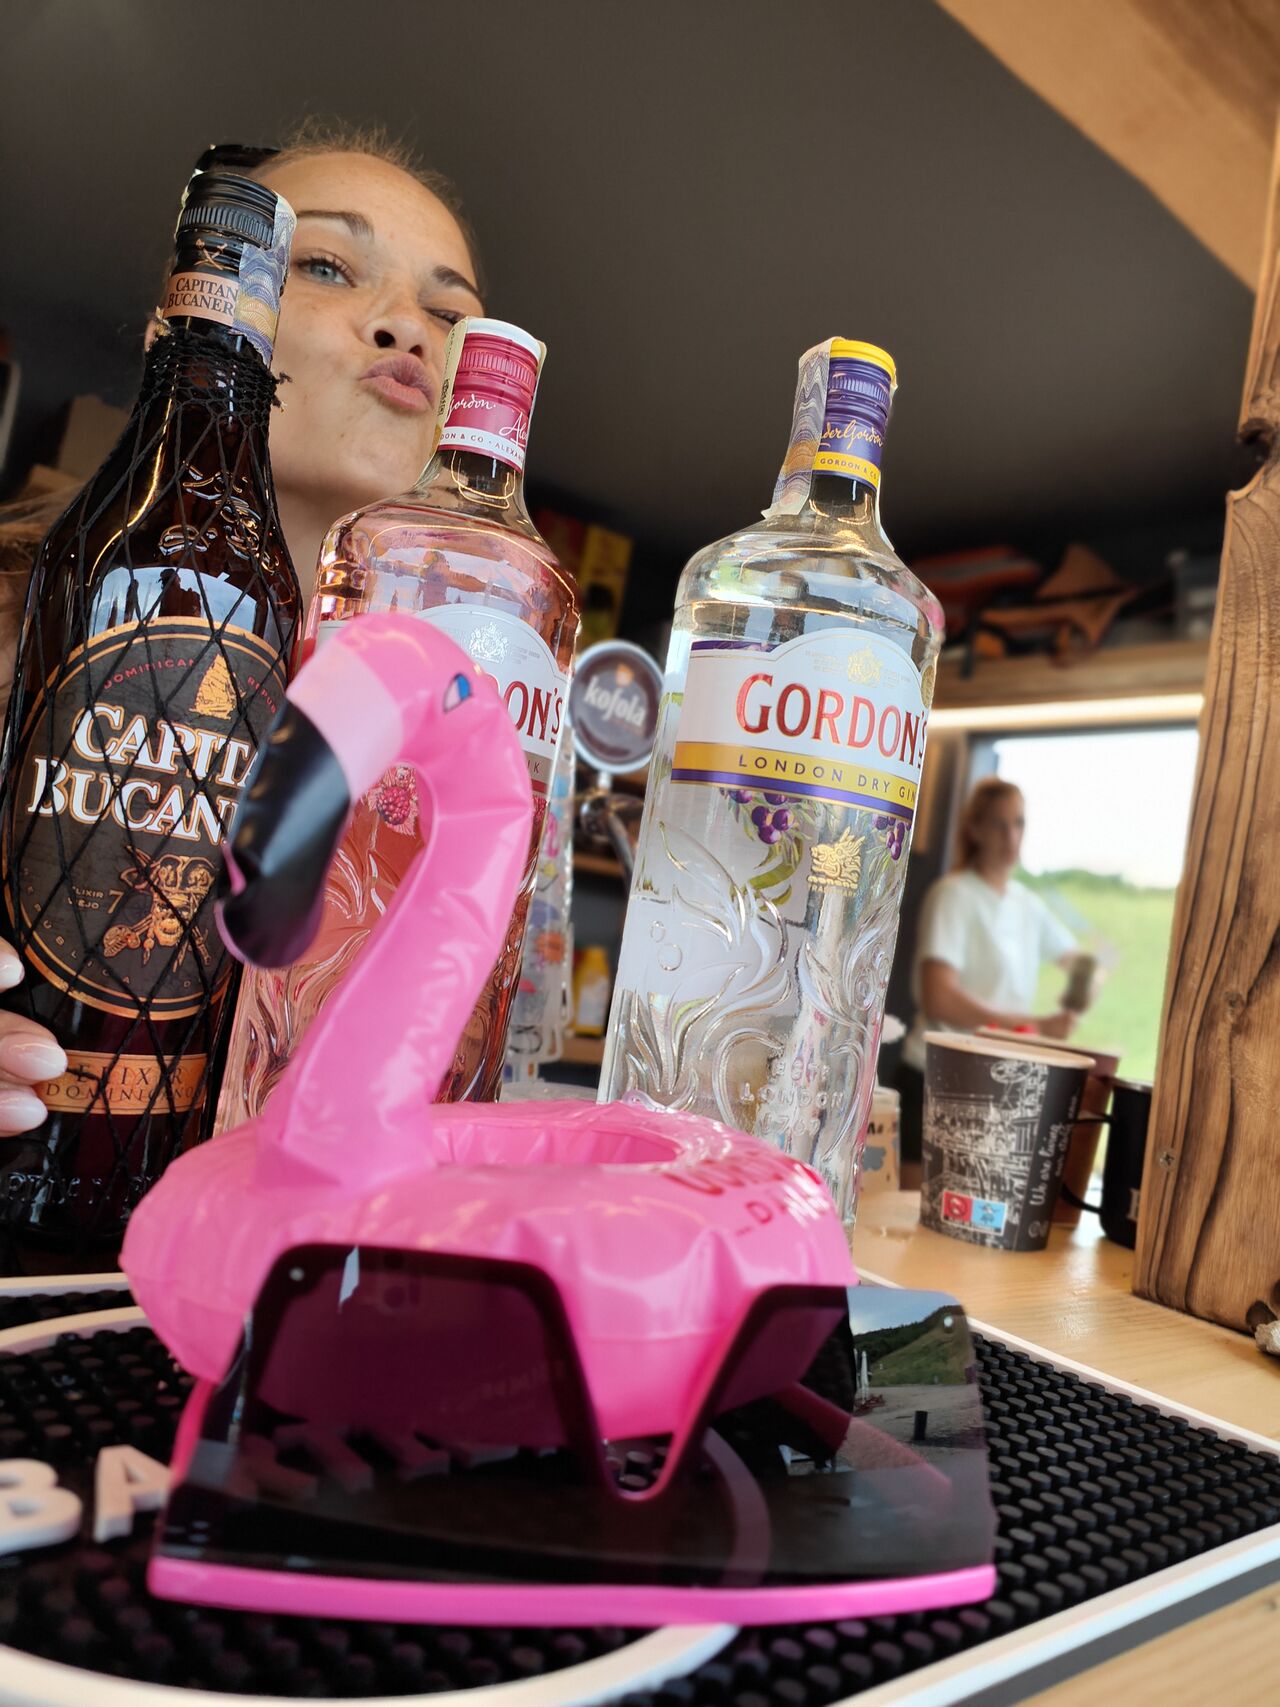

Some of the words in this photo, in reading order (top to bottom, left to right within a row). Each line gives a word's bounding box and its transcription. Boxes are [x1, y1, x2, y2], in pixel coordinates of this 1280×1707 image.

[176, 278, 239, 301] CAPITAN
[820, 458, 860, 471] GORDON
[487, 673, 563, 745] ON'S
[583, 675, 647, 727] kofola
[738, 754, 843, 783] LONDON
[857, 775, 890, 793] DRY
[107, 890, 124, 914] 7
[76, 1063, 183, 1086] EIXR
